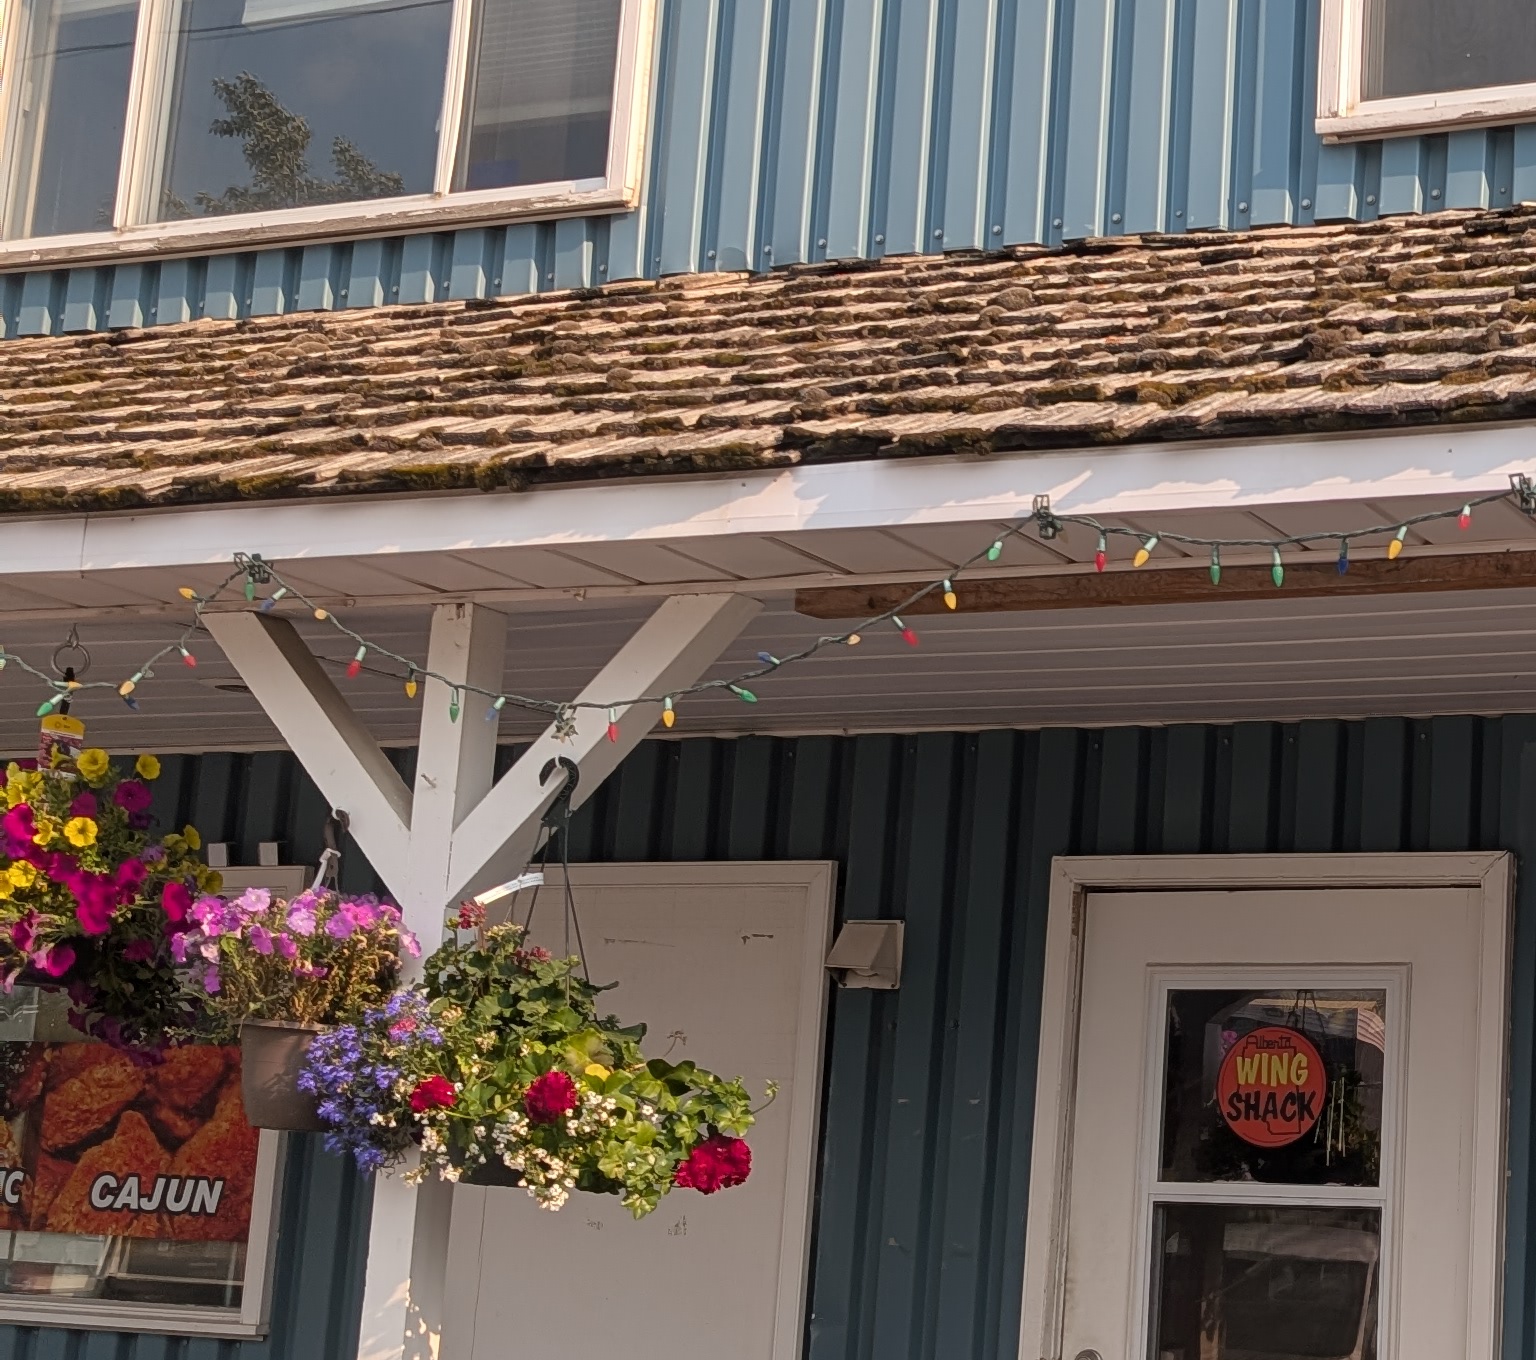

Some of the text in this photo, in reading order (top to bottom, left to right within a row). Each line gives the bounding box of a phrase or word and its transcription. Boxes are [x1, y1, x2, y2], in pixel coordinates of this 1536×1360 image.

[1245, 1035, 1291, 1049] Alberta
[1236, 1052, 1308, 1087] WING
[1227, 1090, 1316, 1122] SHACK
[91, 1174, 224, 1214] CAJUN
